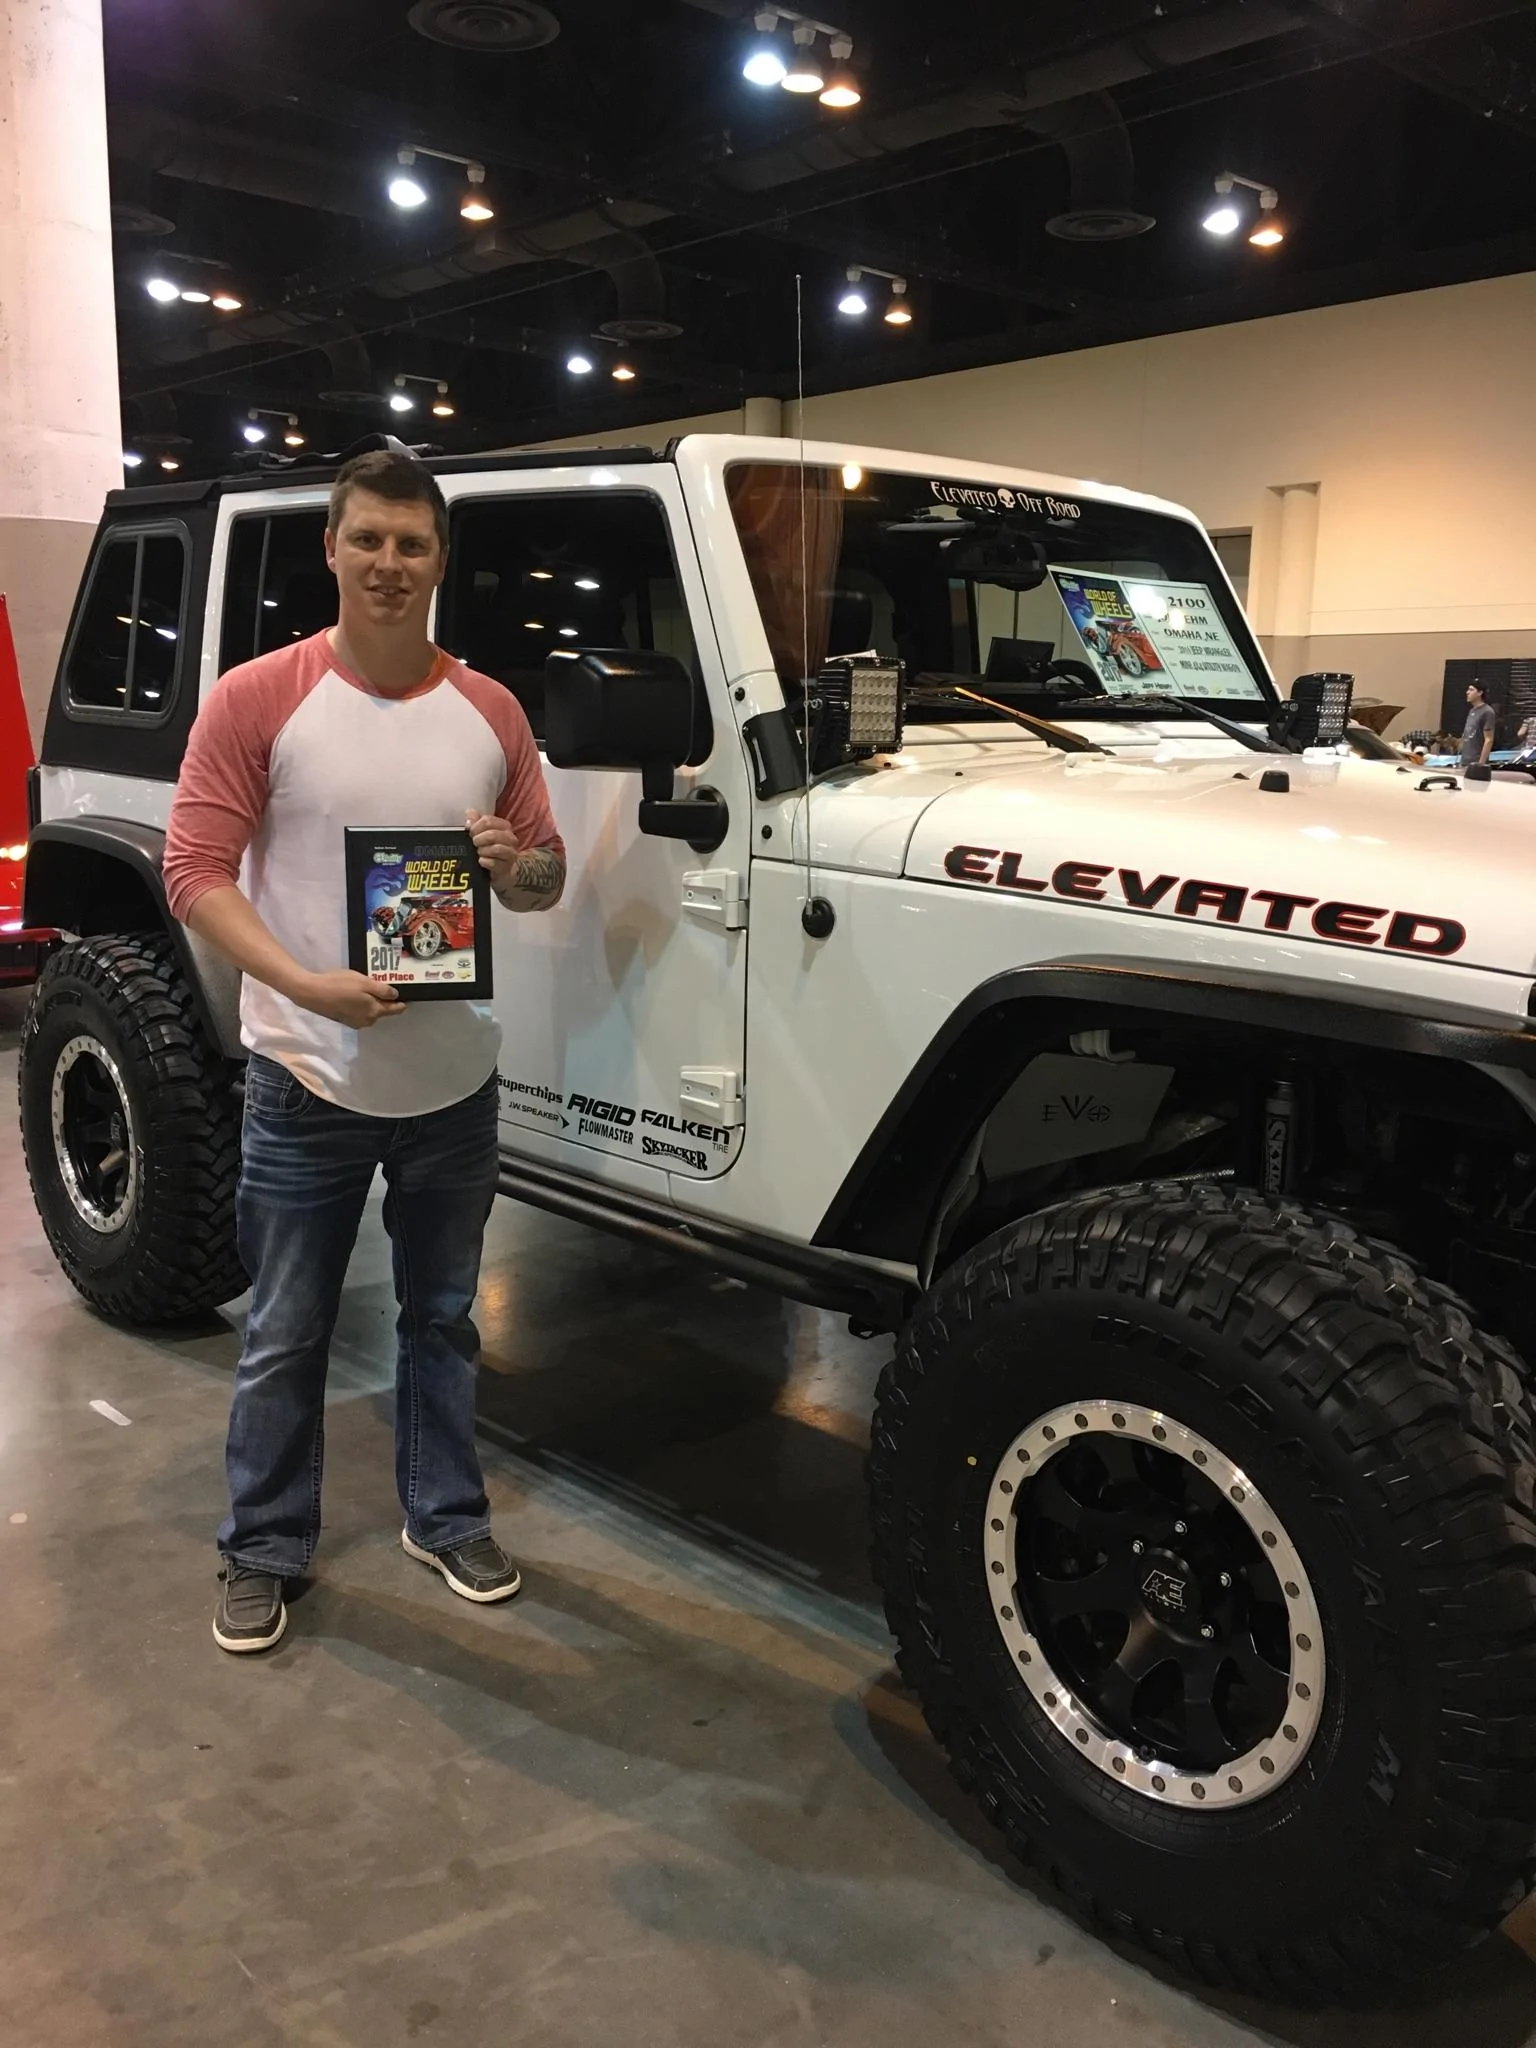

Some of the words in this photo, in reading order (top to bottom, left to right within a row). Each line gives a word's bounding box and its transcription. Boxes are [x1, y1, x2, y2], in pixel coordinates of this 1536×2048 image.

[930, 481, 997, 507] ELEVATED
[1016, 492, 1043, 514] OFF
[1045, 496, 1081, 519] ROAD
[1084, 588, 1108, 601] WORLD
[1107, 590, 1118, 602] OF
[1168, 596, 1206, 609] 2100
[1091, 600, 1134, 619] WHEELS
[1163, 628, 1202, 641] OMAHA
[1096, 661, 1123, 682] 2017
[405, 860, 441, 873] WORLD
[442, 859, 457, 873] OF
[407, 872, 470, 891] WHEELS
[943, 844, 1467, 957] ELEVATED
[370, 946, 402, 971] 2017
[371, 972, 388, 982] 3rd
[389, 972, 415, 981] Place
[497, 1074, 563, 1104] Superchips
[566, 1093, 636, 1127] RIGID
[578, 1117, 634, 1145] FLOWMASTER
[640, 1109, 730, 1145] FALKEN
[641, 1135, 708, 1171] SKYJACKER
[712, 1142, 729, 1154] TIRE
